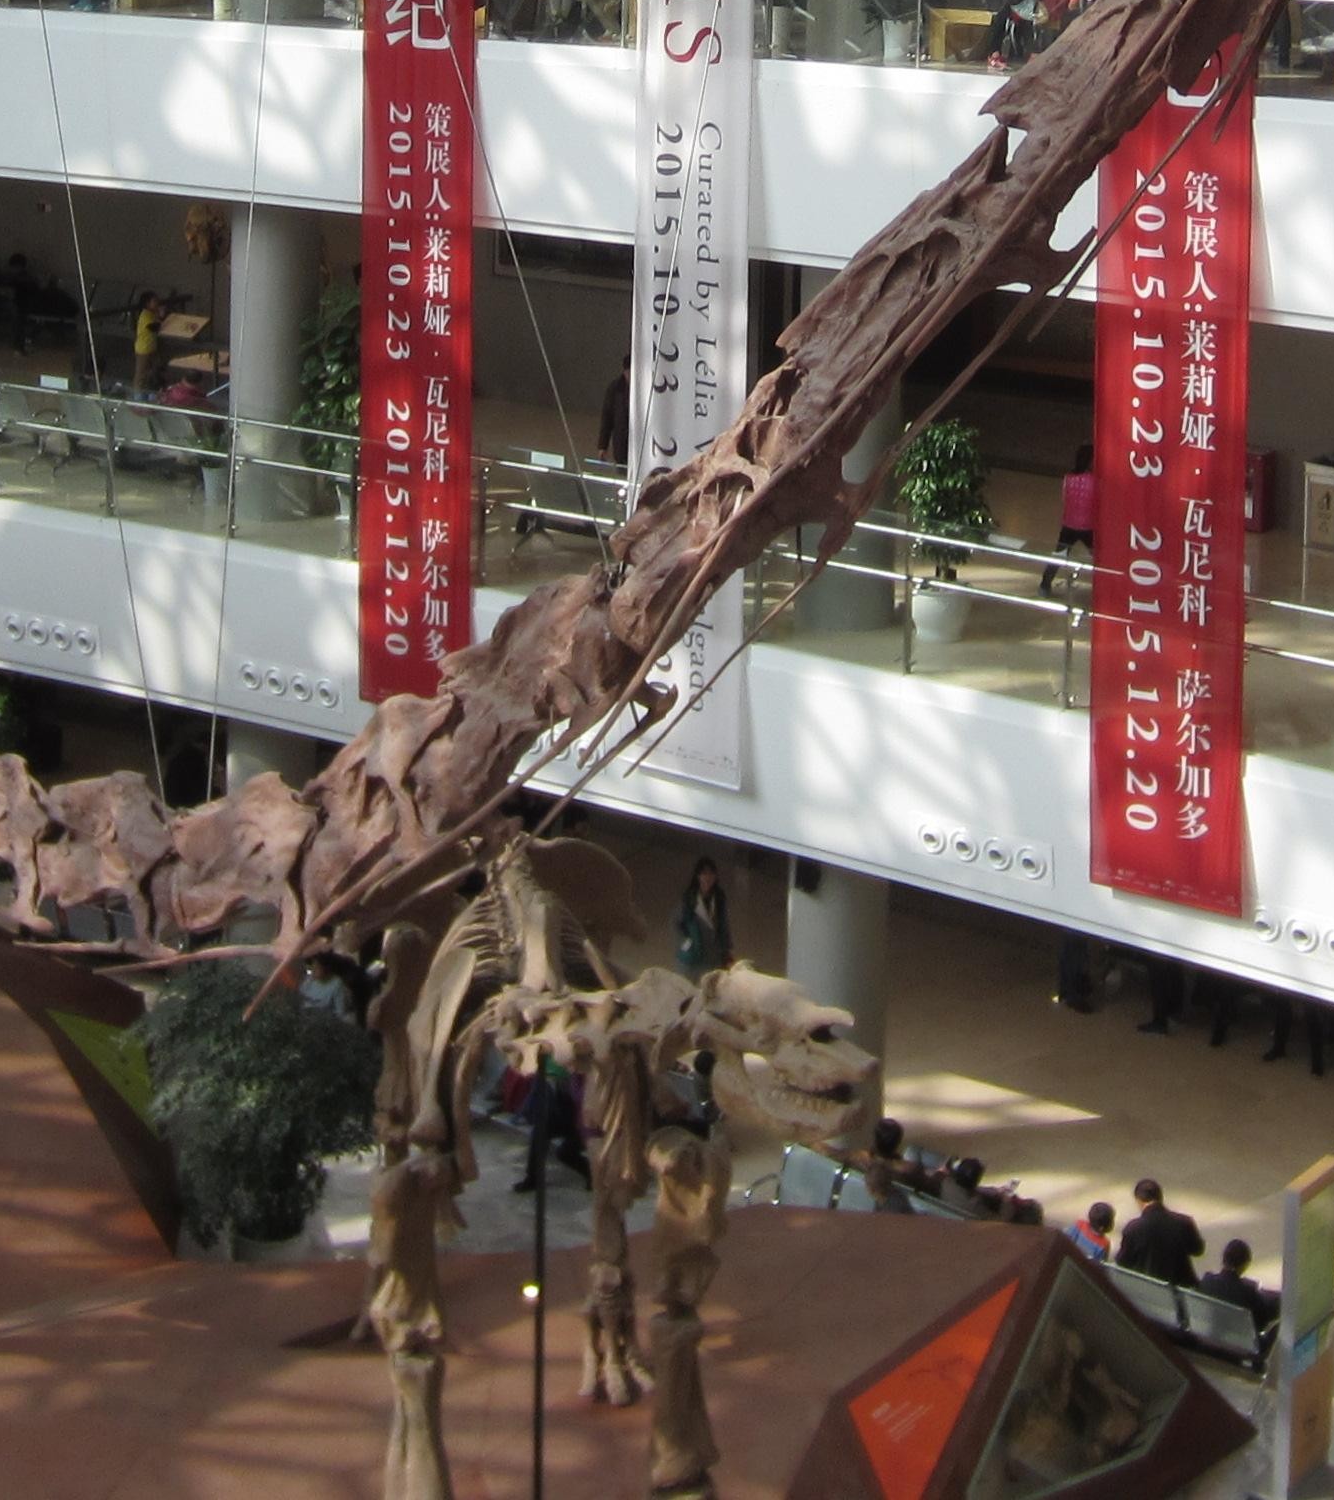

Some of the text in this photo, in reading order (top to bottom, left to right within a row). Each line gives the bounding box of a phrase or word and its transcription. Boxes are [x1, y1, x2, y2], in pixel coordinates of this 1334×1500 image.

[652, 122, 684, 394] 2015.10.23
[696, 121, 723, 265] Curated
[385, 101, 413, 656] 2015.10.23 2015.12.20
[688, 280, 720, 322] by
[693, 334, 718, 420] Lélia
[1125, 169, 1166, 831] 2015.10.23 2015.12.20
